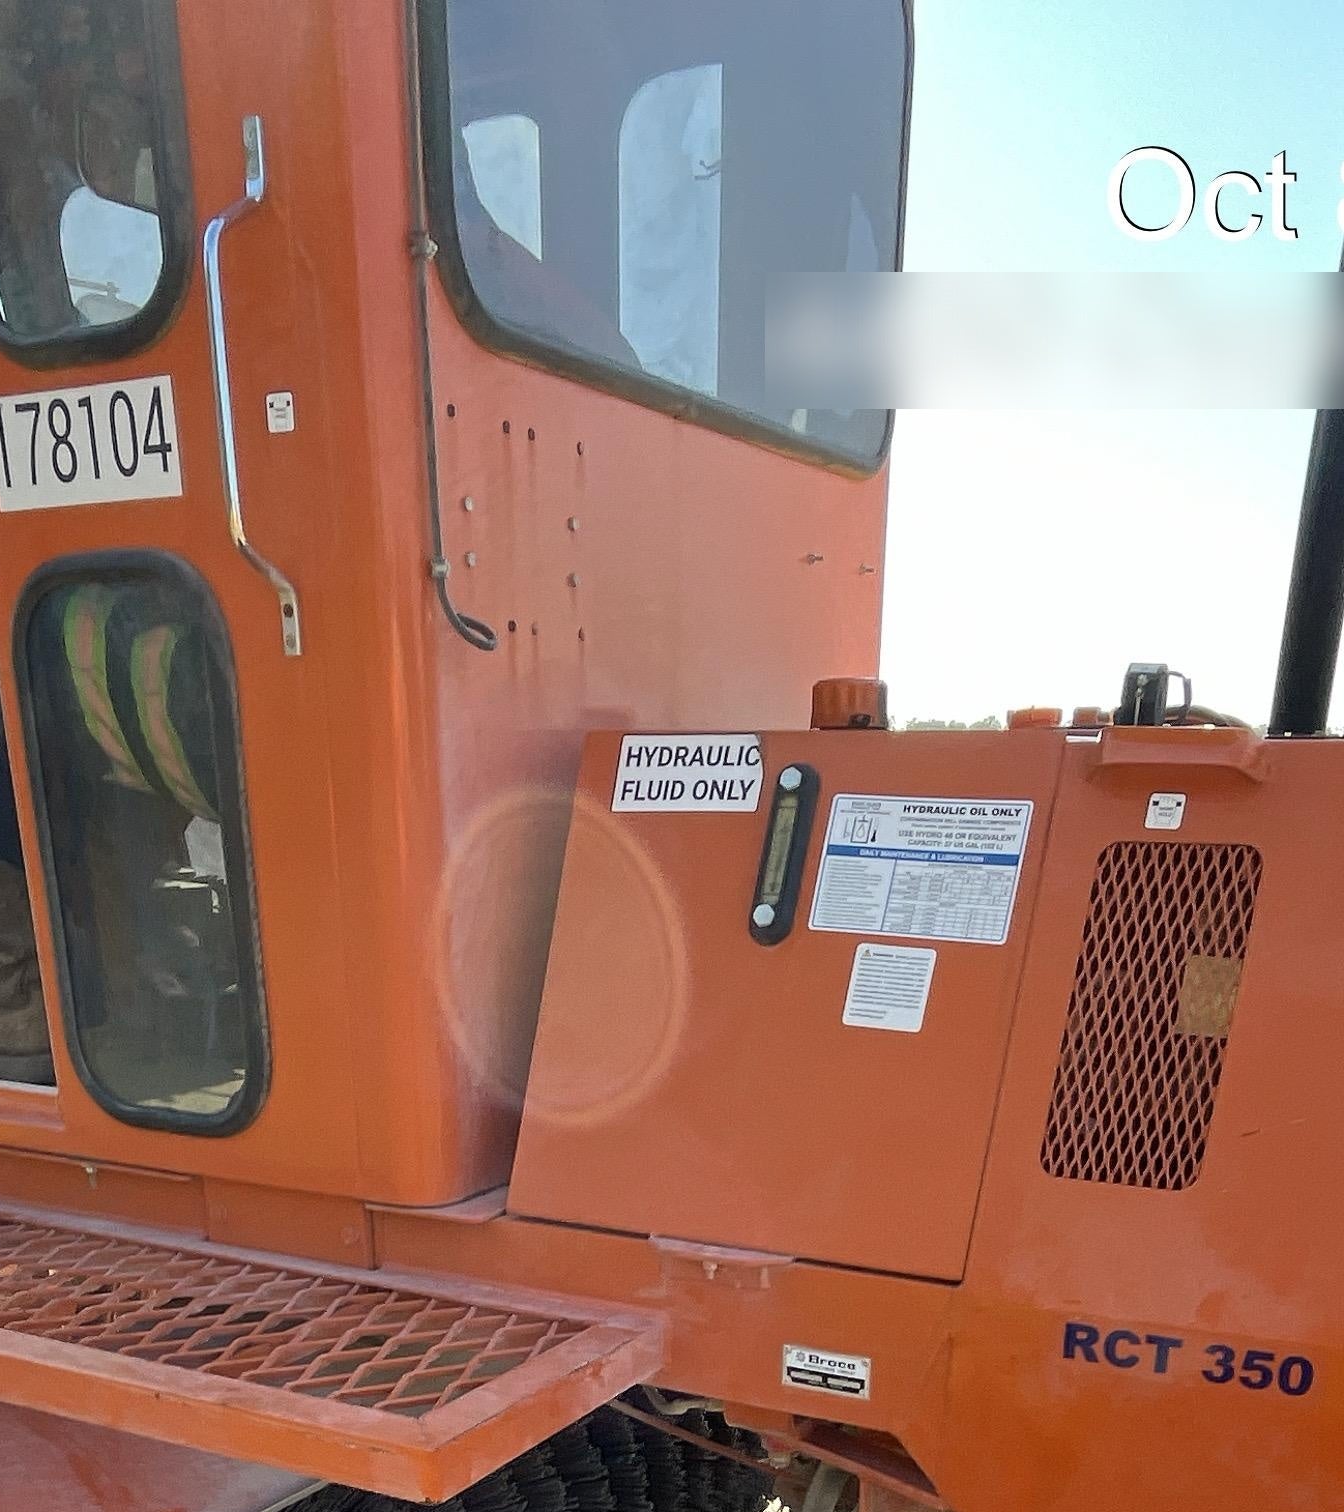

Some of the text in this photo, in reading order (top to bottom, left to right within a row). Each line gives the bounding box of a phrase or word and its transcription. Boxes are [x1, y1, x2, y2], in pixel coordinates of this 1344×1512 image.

[625, 745, 760, 767] HYDRAULIC
[621, 780, 755, 801] FLUID ONLY
[903, 804, 1023, 817] HYDRAULIC OIL ONLY
[1062, 1321, 1314, 1397] RCT 350
